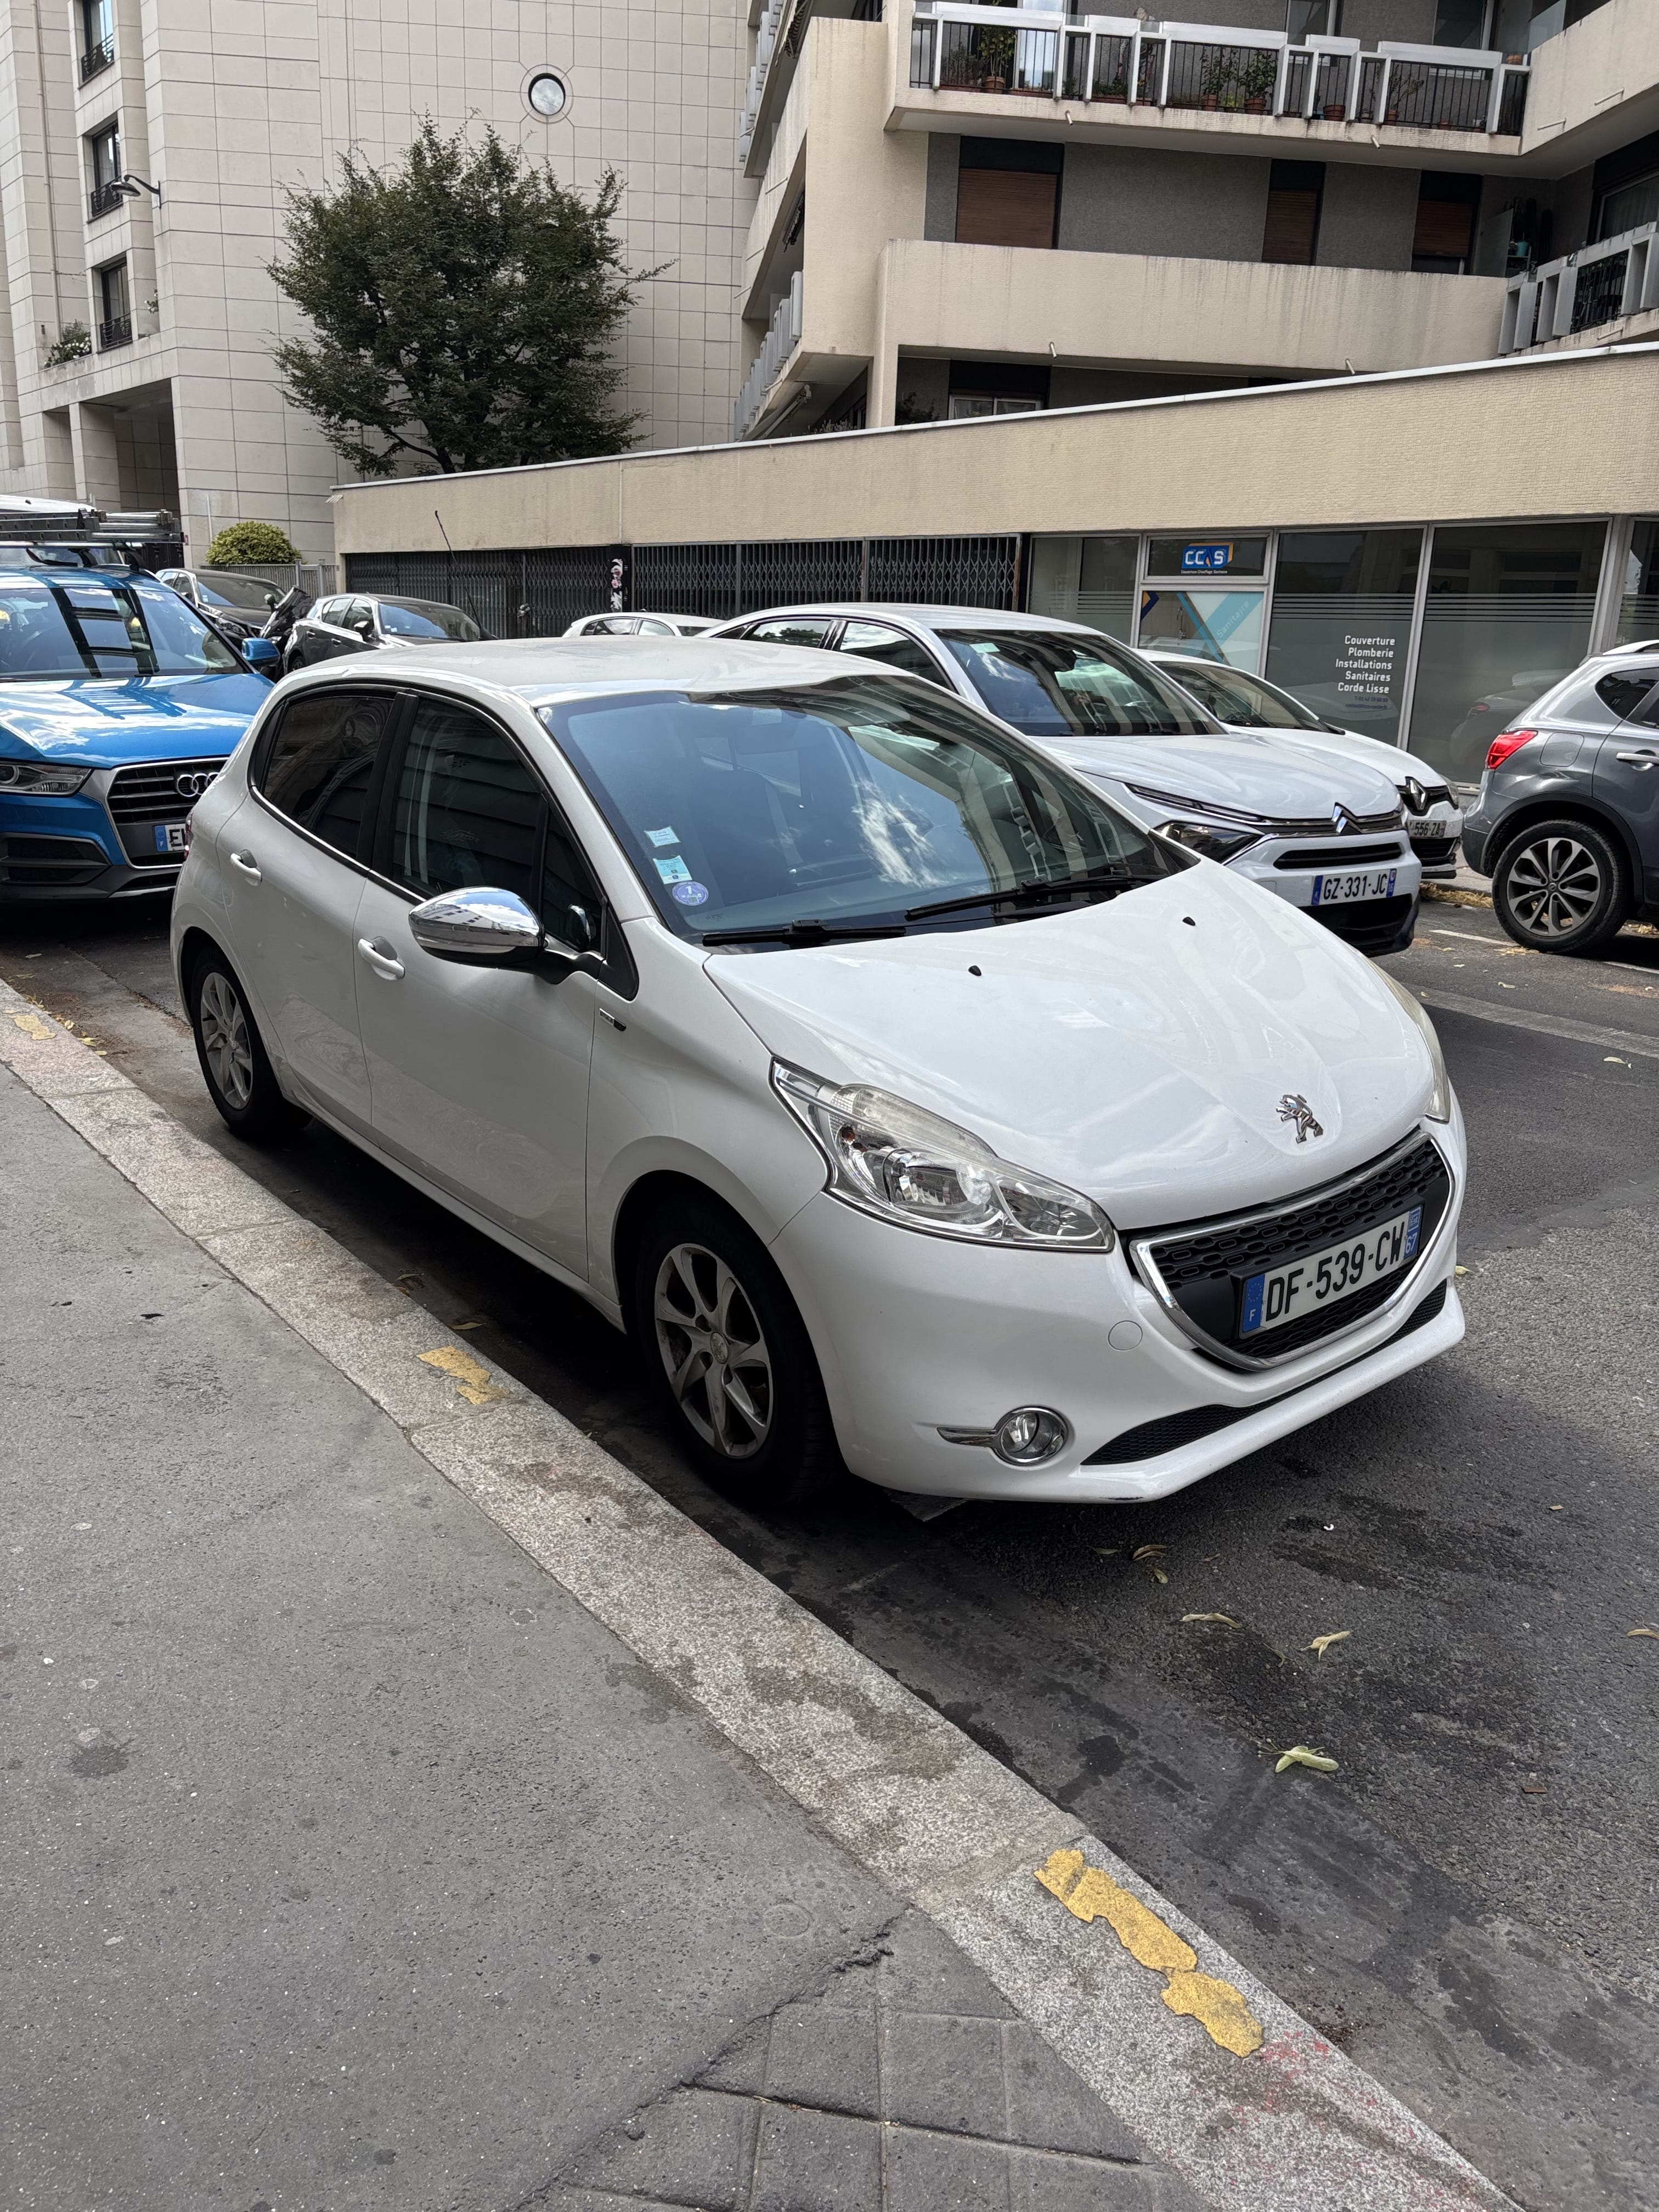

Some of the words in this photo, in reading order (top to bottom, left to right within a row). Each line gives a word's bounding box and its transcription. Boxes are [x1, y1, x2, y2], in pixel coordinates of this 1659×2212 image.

[1216, 601, 1249, 637] Sanitaire
[1344, 635, 1395, 646] Couverture
[1348, 647, 1393, 658] Plomberie
[1335, 658, 1392, 670] Installations
[1345, 670, 1391, 681] Sanitaires
[1338, 682, 1364, 692] Corde
[1366, 683, 1390, 694] Lisse
[1406, 1232, 1418, 1254] 67
[1265, 1221, 1405, 1322] DF-539-CW
[1249, 1308, 1256, 1322] F
